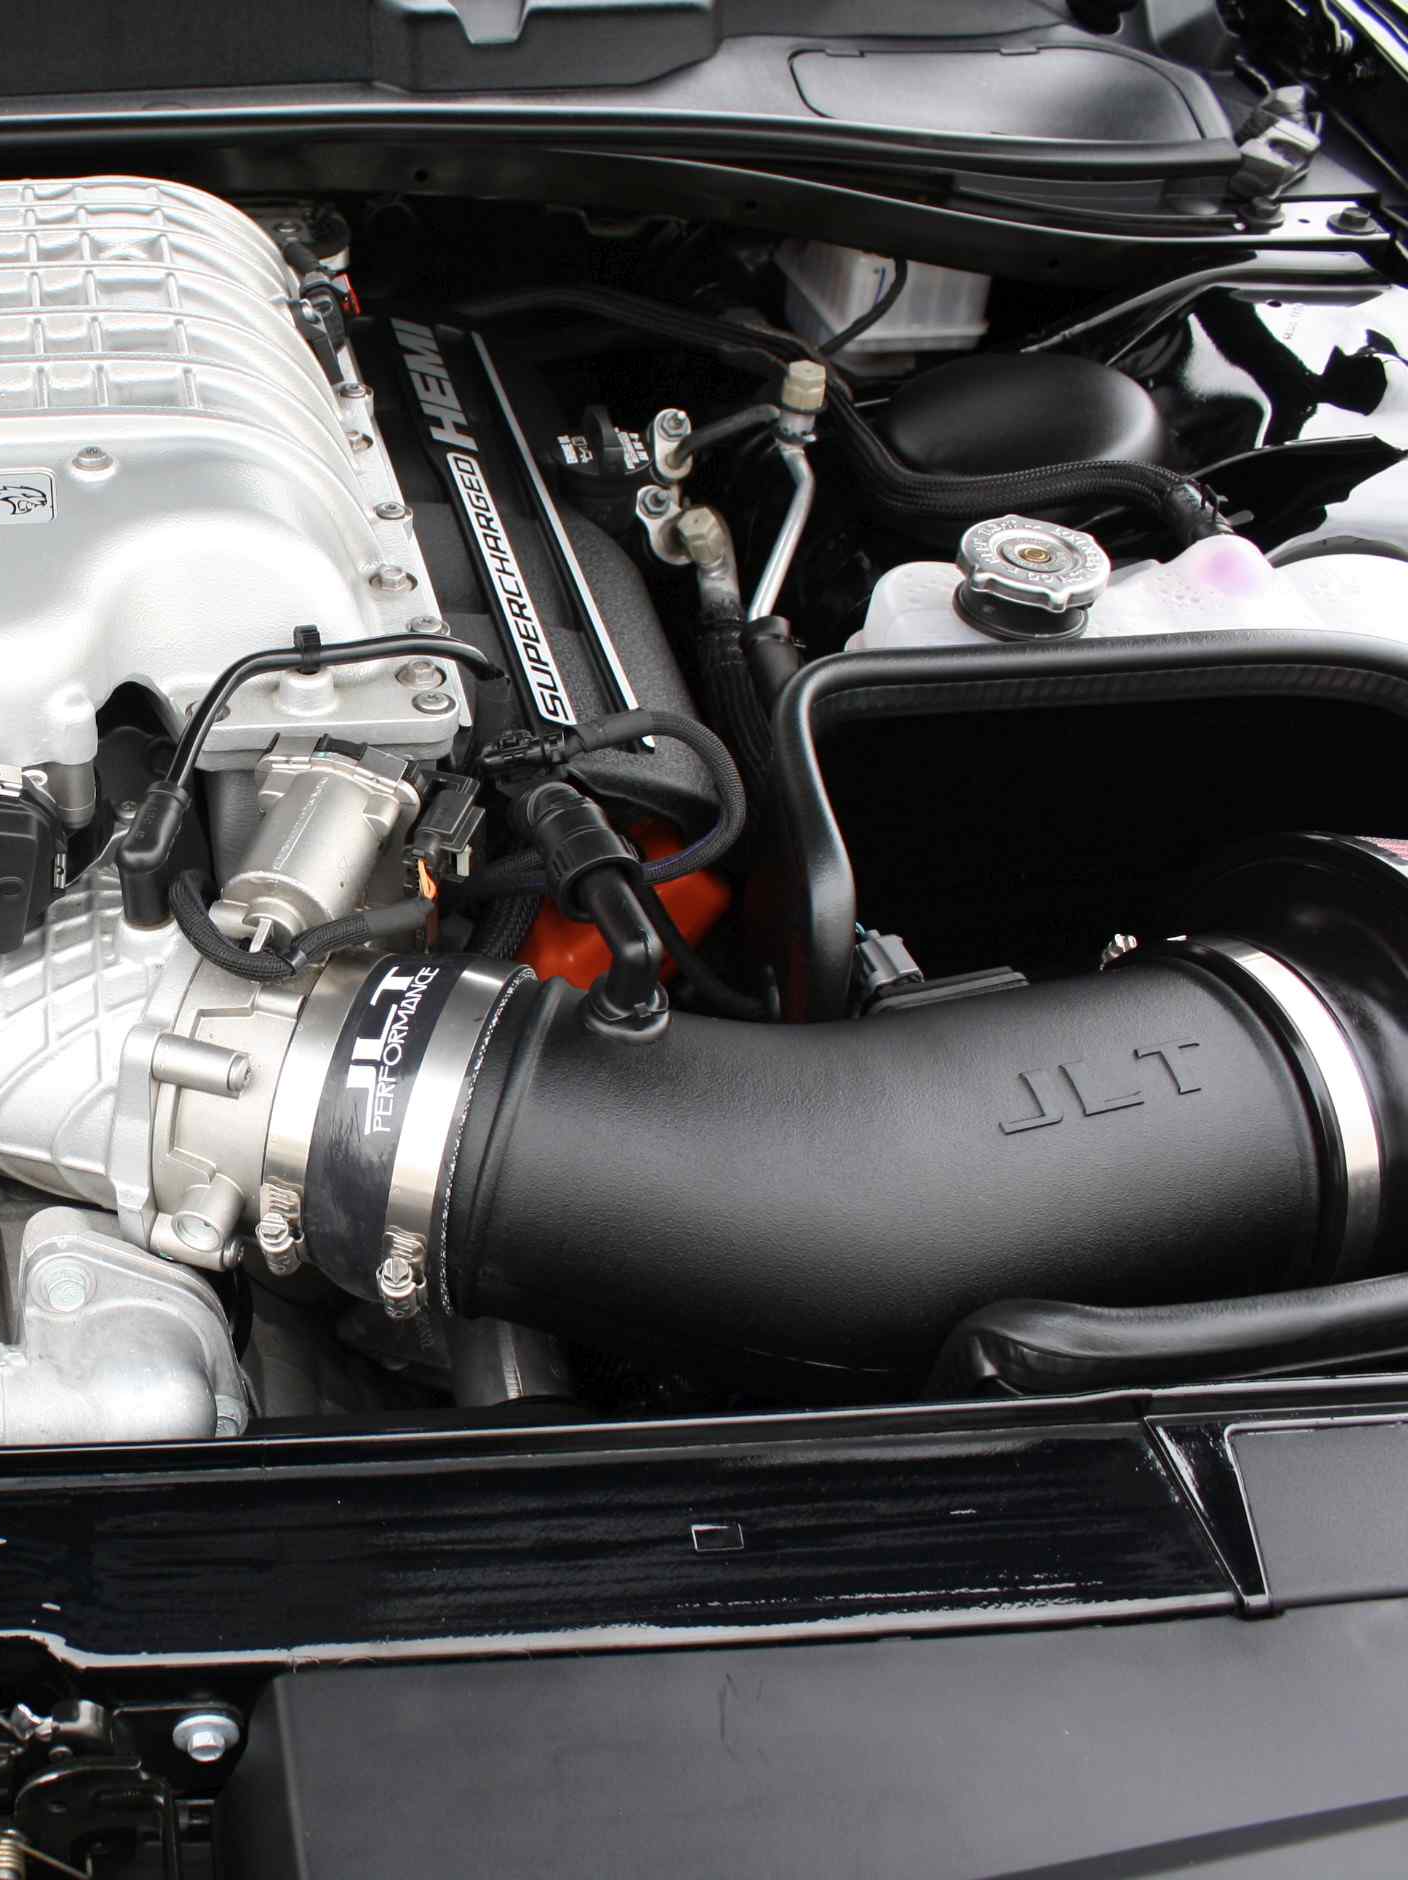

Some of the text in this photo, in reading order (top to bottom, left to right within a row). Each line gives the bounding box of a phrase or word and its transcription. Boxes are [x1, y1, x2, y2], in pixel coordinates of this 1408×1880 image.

[391, 318, 570, 722] SUPERCHARGED HEMI
[346, 966, 415, 1136] JLT
[372, 966, 441, 1133] PERFORMANCE
[998, 1037, 1202, 1136] JLT
